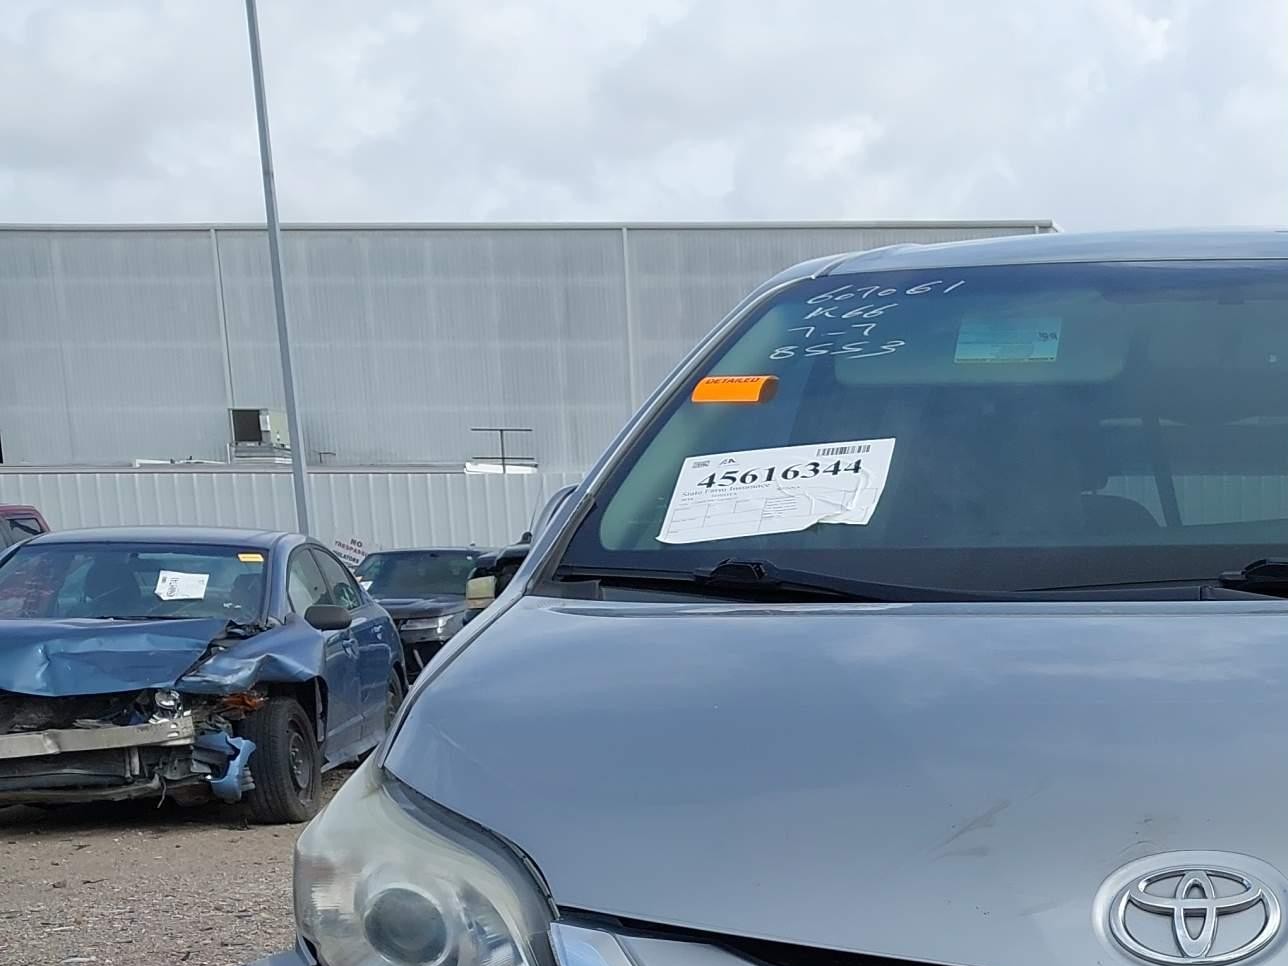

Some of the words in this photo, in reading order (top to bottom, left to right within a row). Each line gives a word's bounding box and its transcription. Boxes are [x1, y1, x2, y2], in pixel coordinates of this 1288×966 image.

[769, 340, 906, 360] 8553
[697, 458, 862, 489] 45616344
[335, 540, 369, 557] TRESPASS
[350, 538, 363, 548] NO
